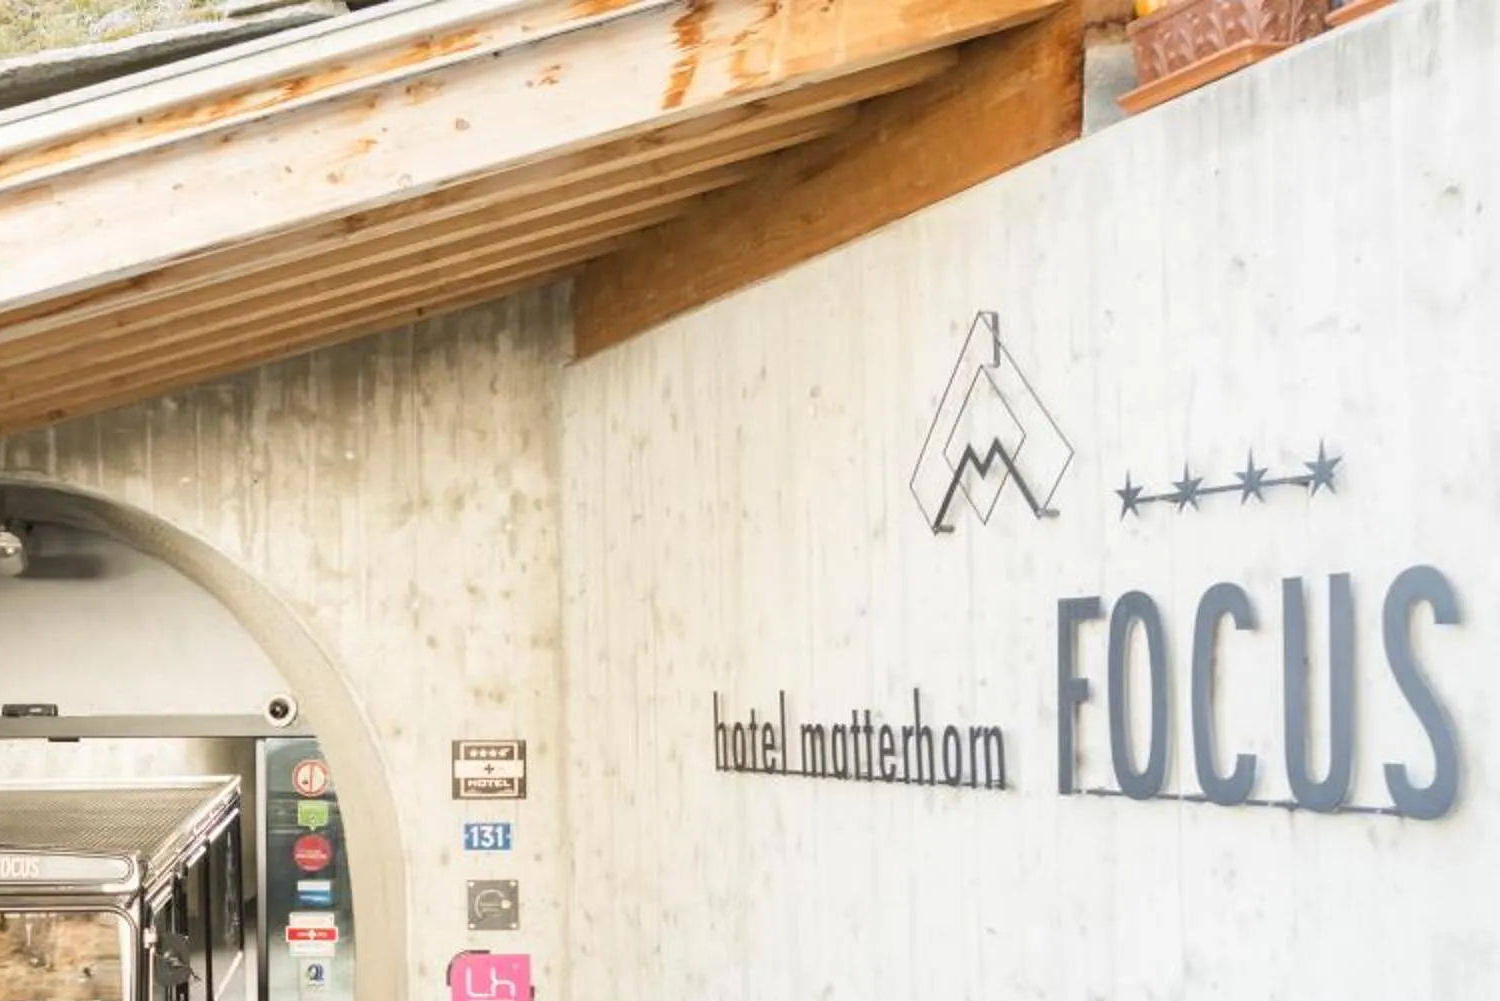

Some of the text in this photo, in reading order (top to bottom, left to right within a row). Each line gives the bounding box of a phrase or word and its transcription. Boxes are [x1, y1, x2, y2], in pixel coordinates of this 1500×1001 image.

[714, 564, 1461, 820] hotel matterhorn FOCUS
[470, 825, 504, 848] 131
